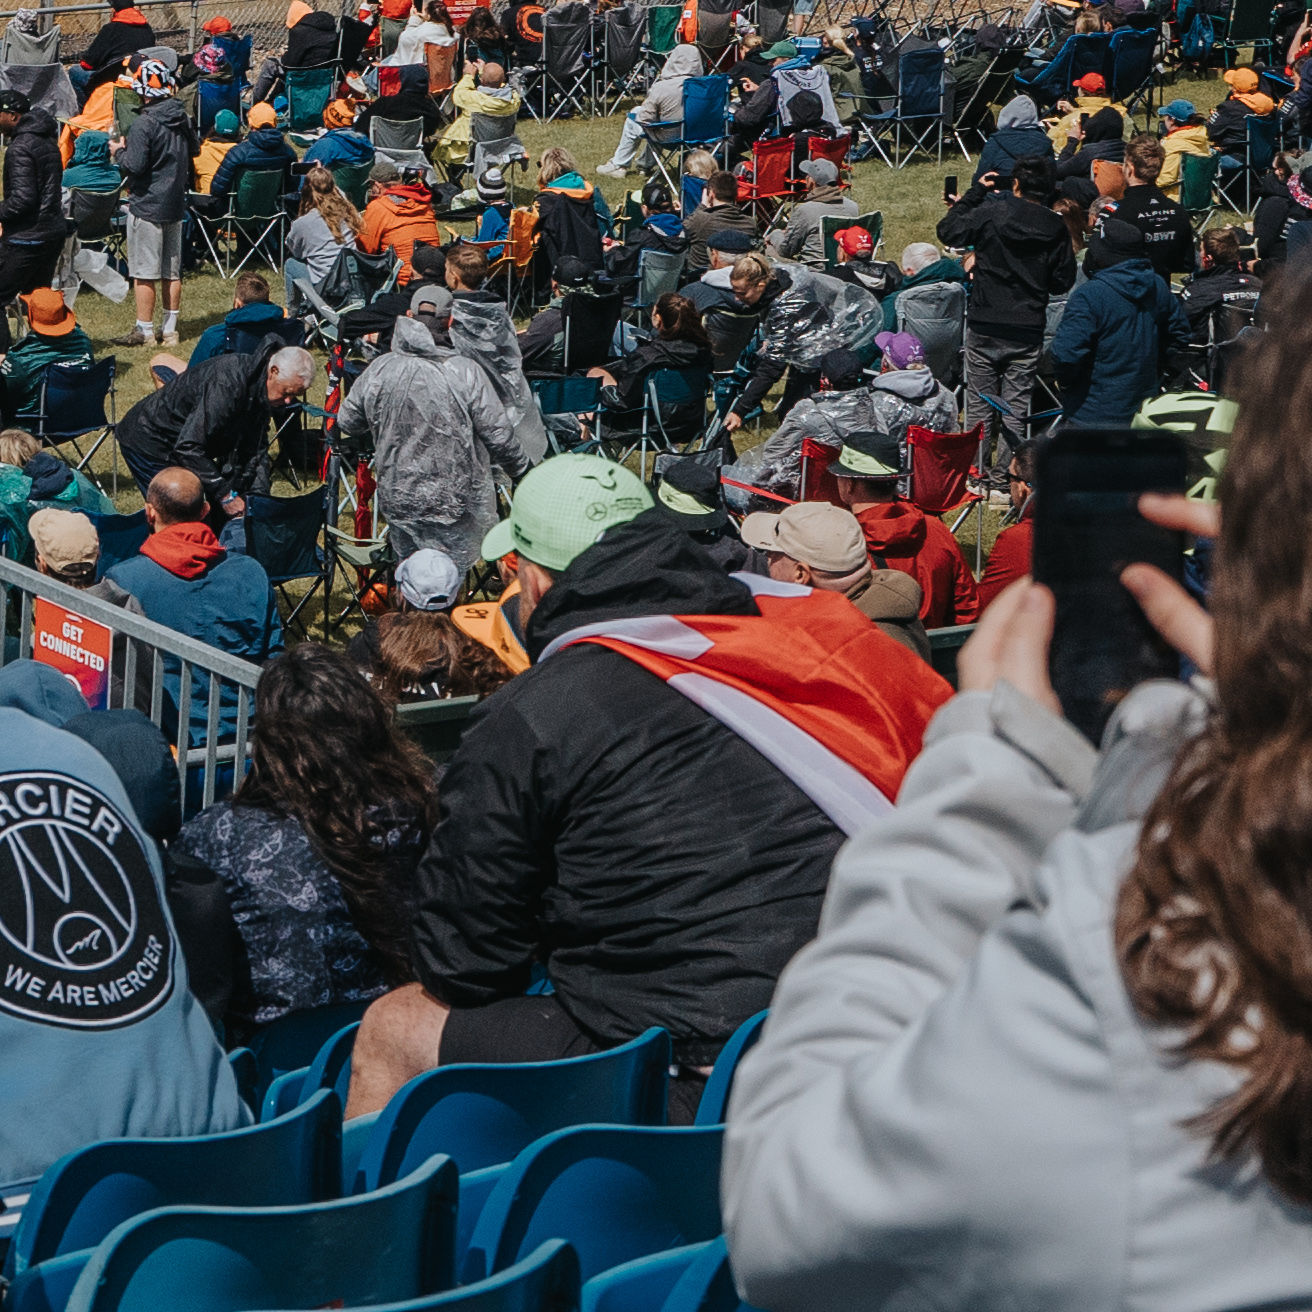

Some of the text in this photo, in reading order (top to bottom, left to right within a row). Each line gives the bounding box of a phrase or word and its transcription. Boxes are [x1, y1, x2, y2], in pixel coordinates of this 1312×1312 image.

[1137, 209, 1176, 219] ALPINE
[62, 621, 84, 644] GET
[39, 630, 105, 672] CONNECTED
[3, 963, 46, 999] WE
[47, 980, 100, 1007] ARE
[101, 933, 164, 1006] MERCIER
